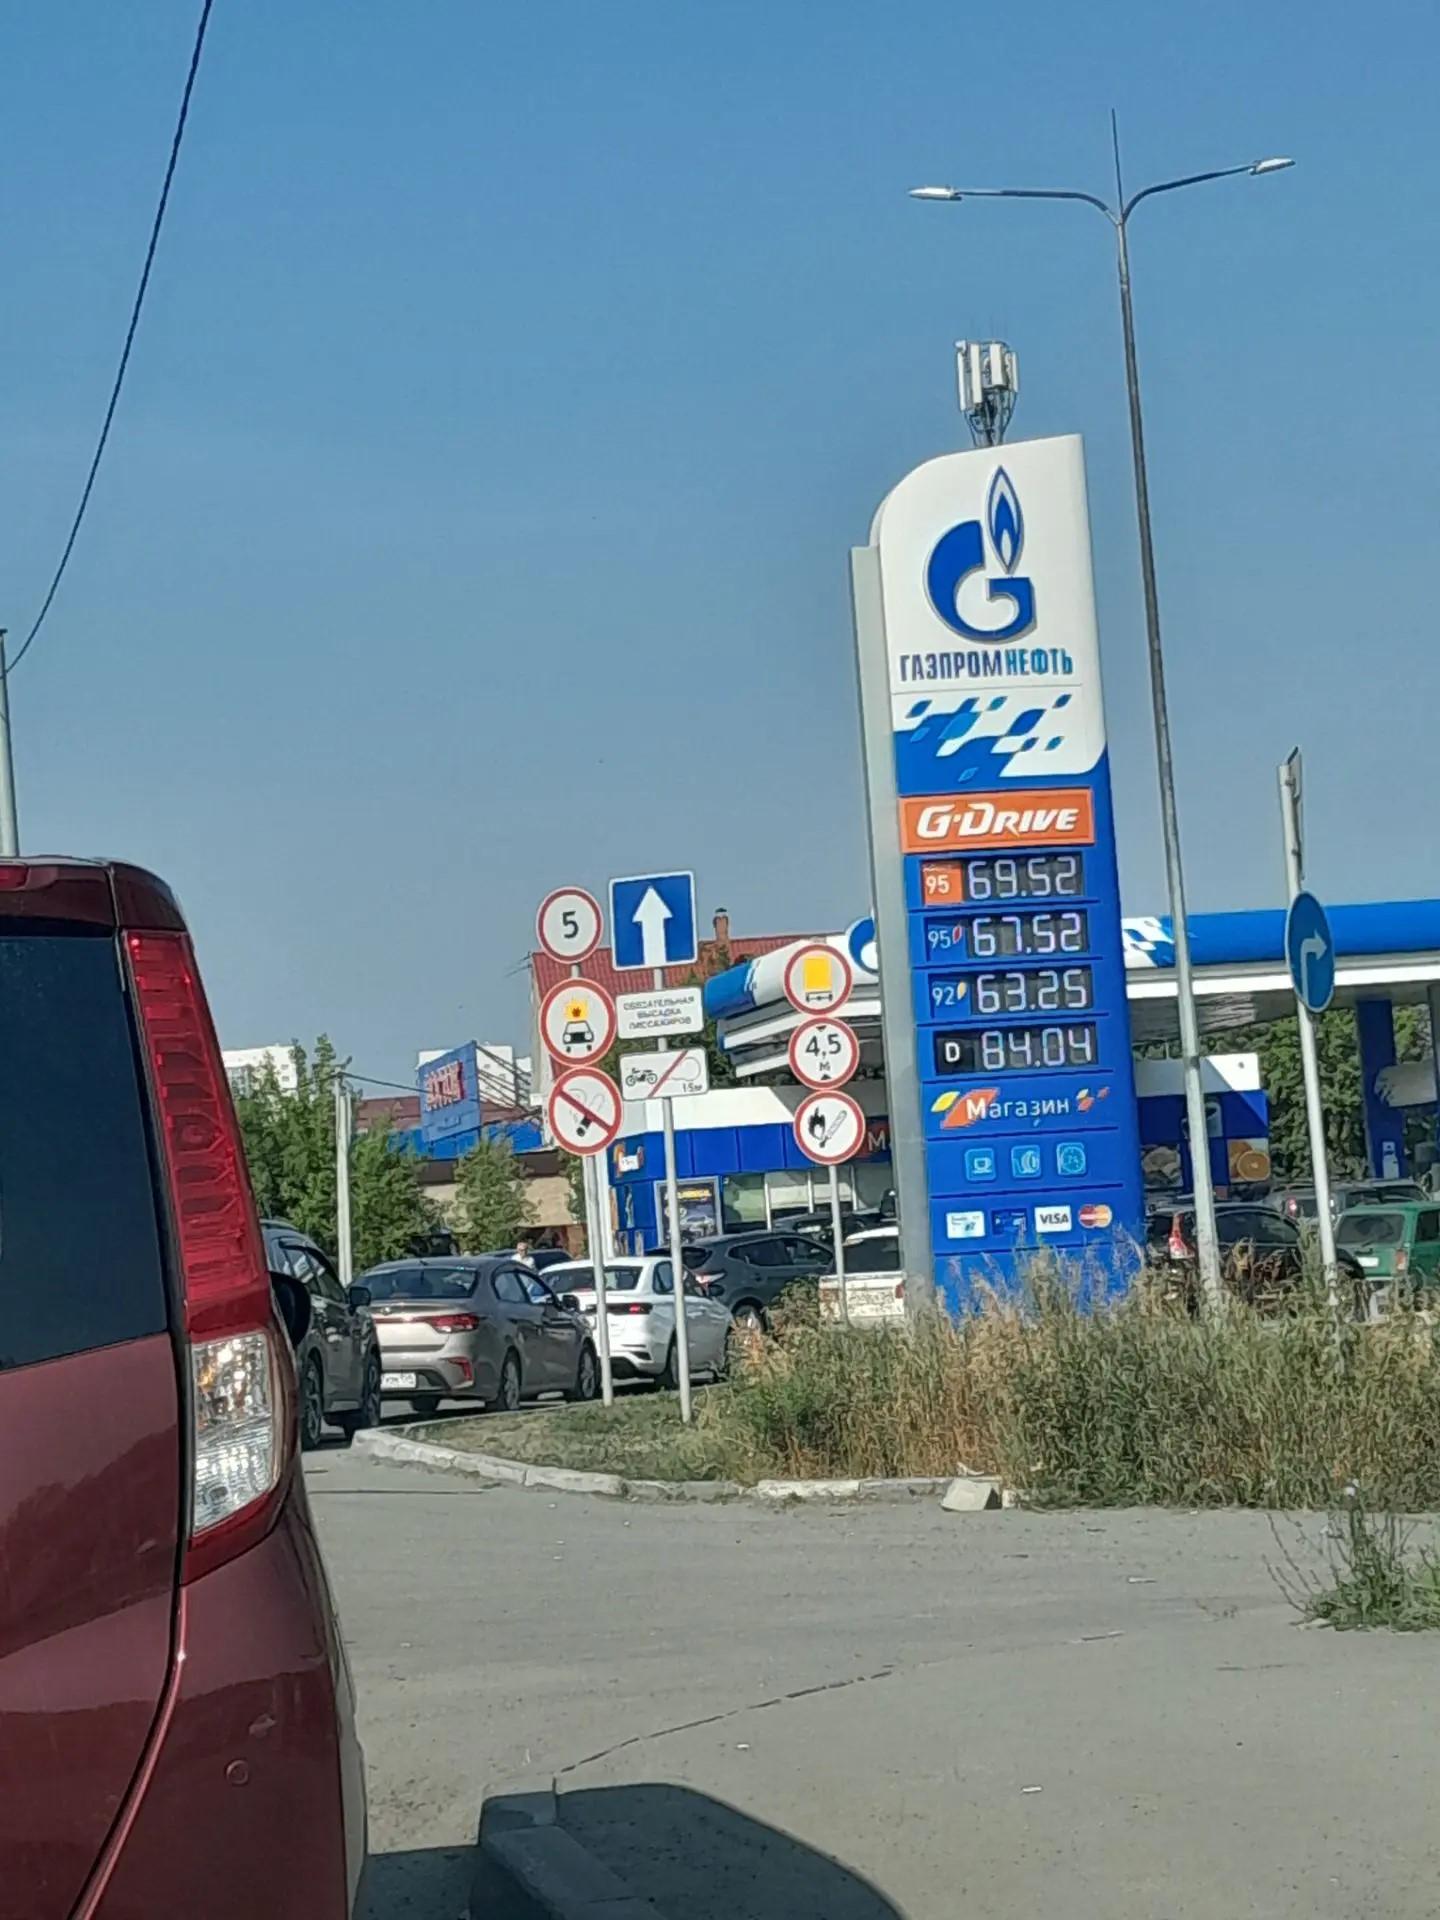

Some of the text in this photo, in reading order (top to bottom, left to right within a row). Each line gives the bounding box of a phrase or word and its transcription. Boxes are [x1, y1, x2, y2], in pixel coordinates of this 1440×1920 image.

[900, 648, 1074, 682] ГАЗПРОМНЕФТЬ
[926, 856, 1076, 900] 95 69.52
[562, 911, 579, 939] 5
[928, 912, 1081, 956] 95 67.52
[932, 969, 1087, 1013] 92 63.25
[805, 1034, 842, 1059] 4,5
[945, 1027, 1092, 1070] D 84.04
[966, 1099, 1070, 1120] Магазин
[1040, 1213, 1069, 1225] VISA
